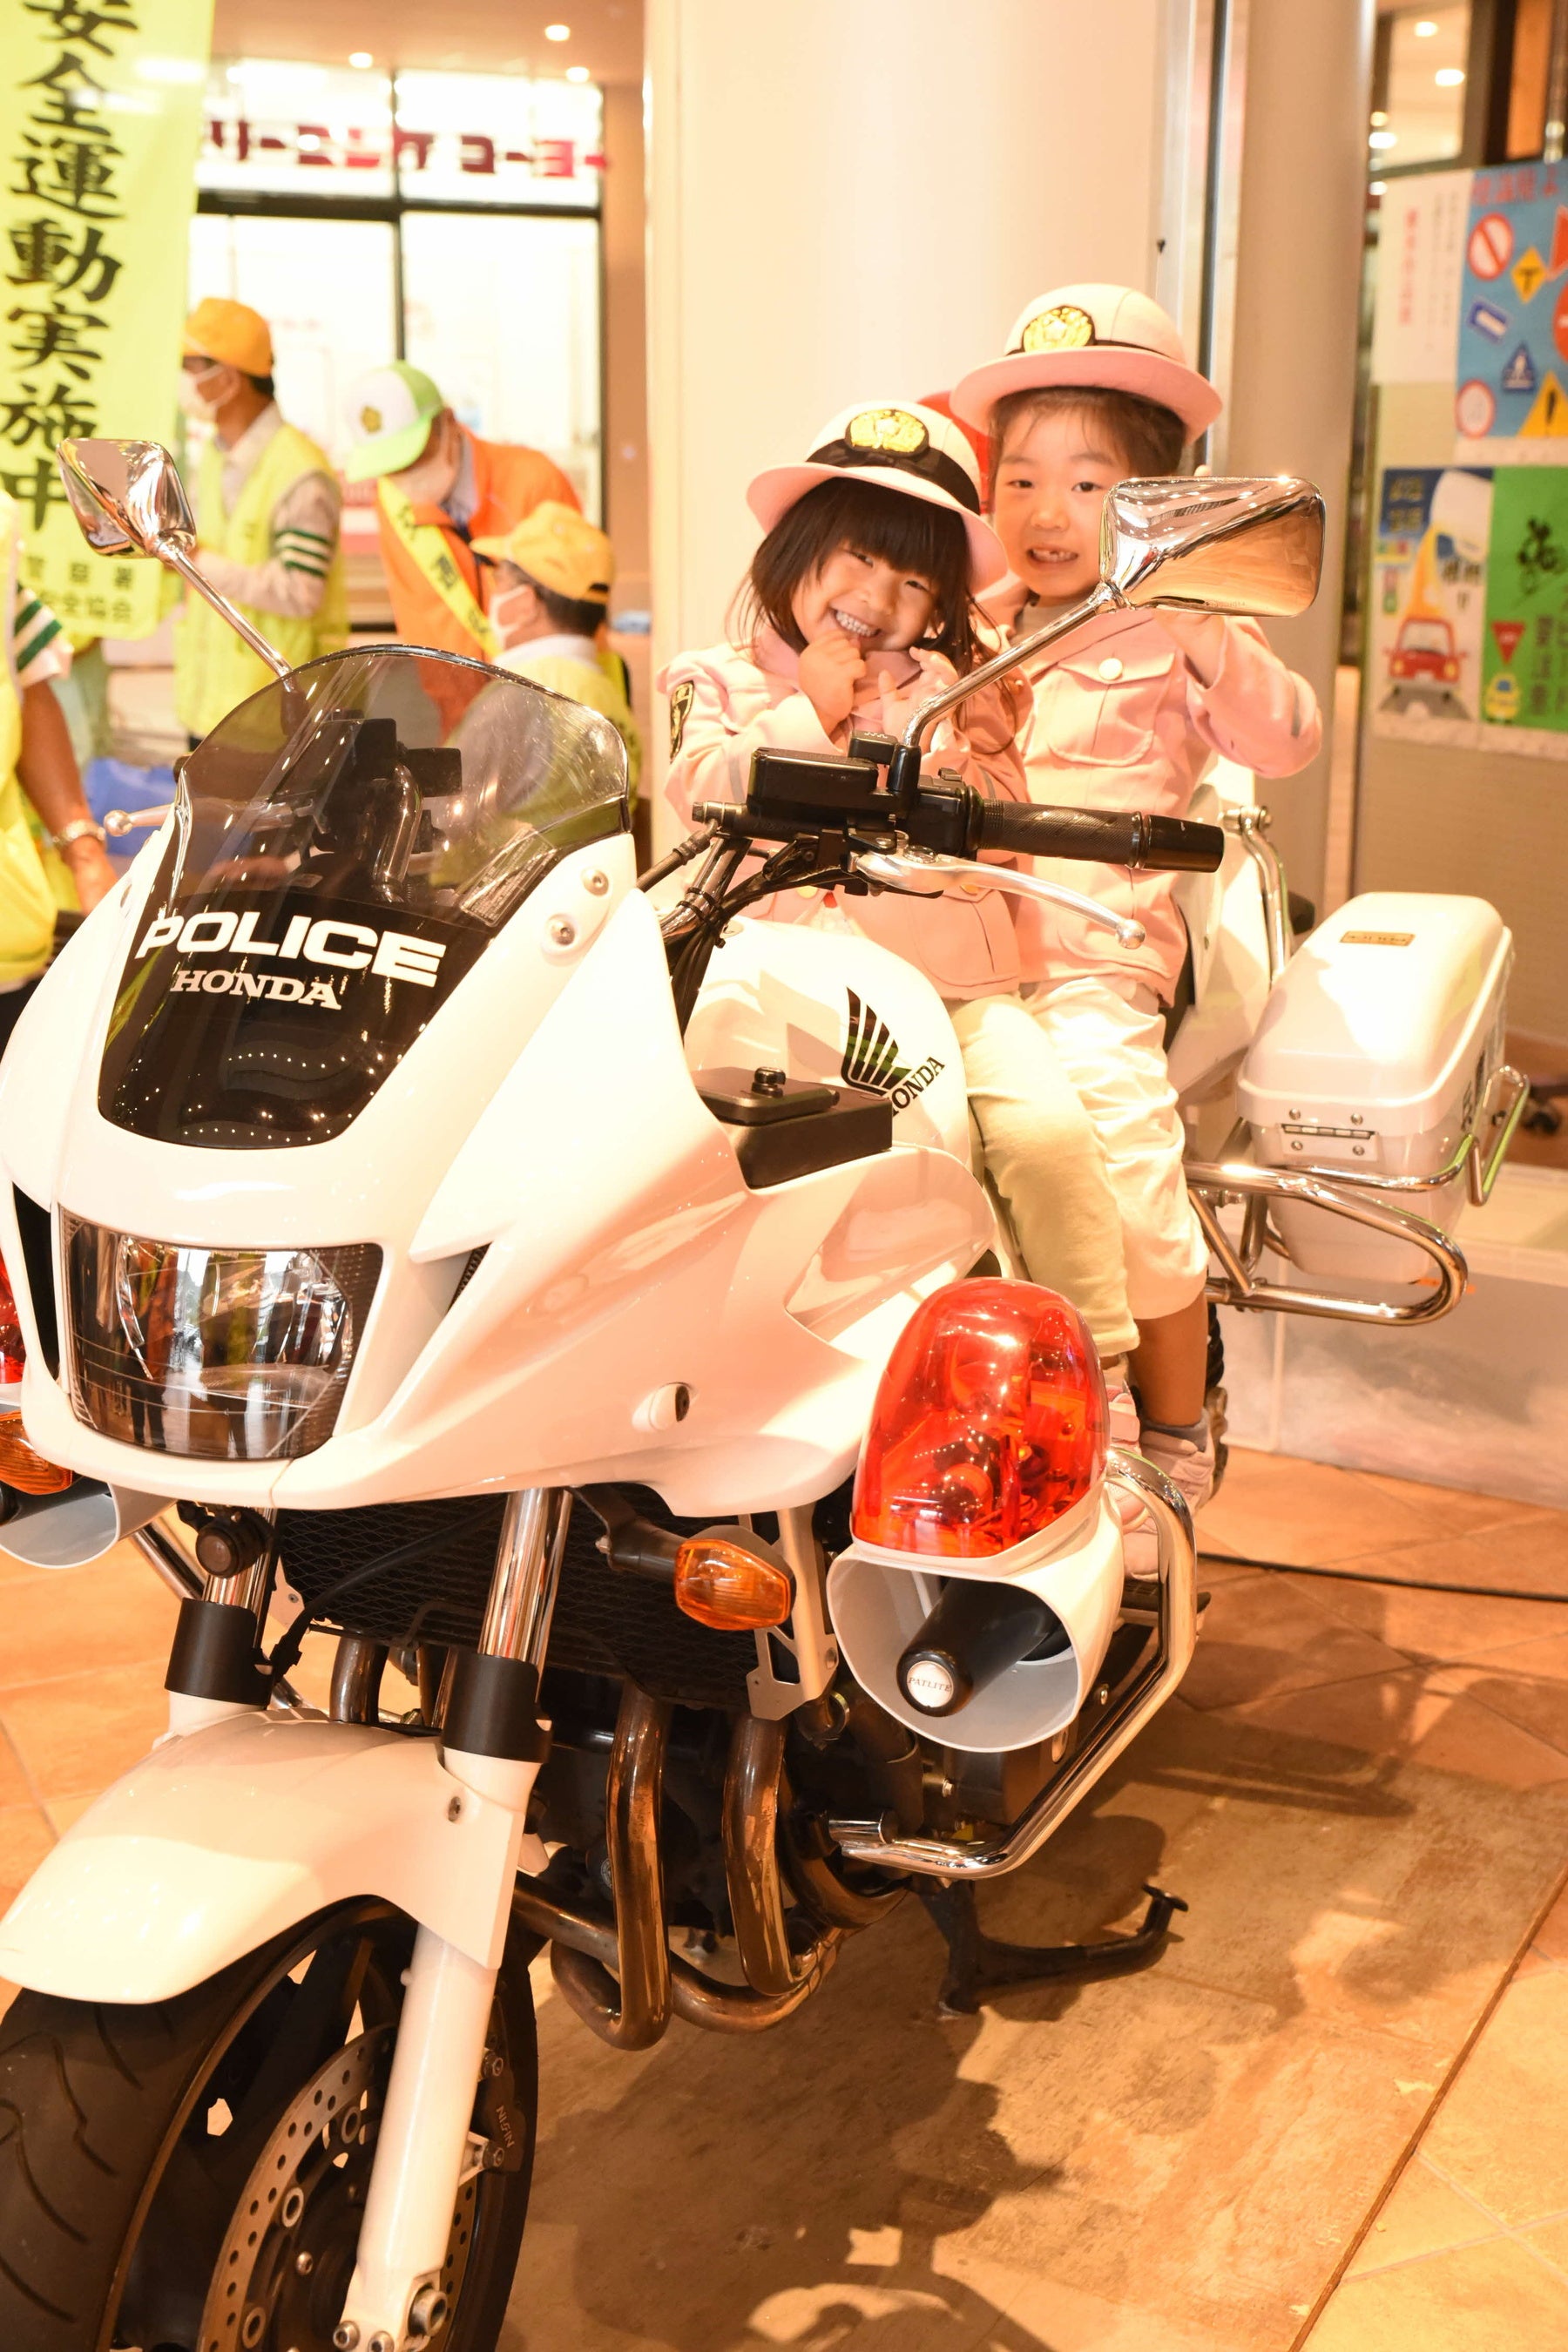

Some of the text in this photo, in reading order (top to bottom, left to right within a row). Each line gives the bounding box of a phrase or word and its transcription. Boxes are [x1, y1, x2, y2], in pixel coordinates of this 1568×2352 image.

[135, 911, 447, 988] POLICE
[170, 970, 341, 1010] HONDA
[891, 1057, 945, 1117] ONDA
[908, 1677, 952, 1692] PATLITE
[497, 2105, 515, 2147] NISSIN
